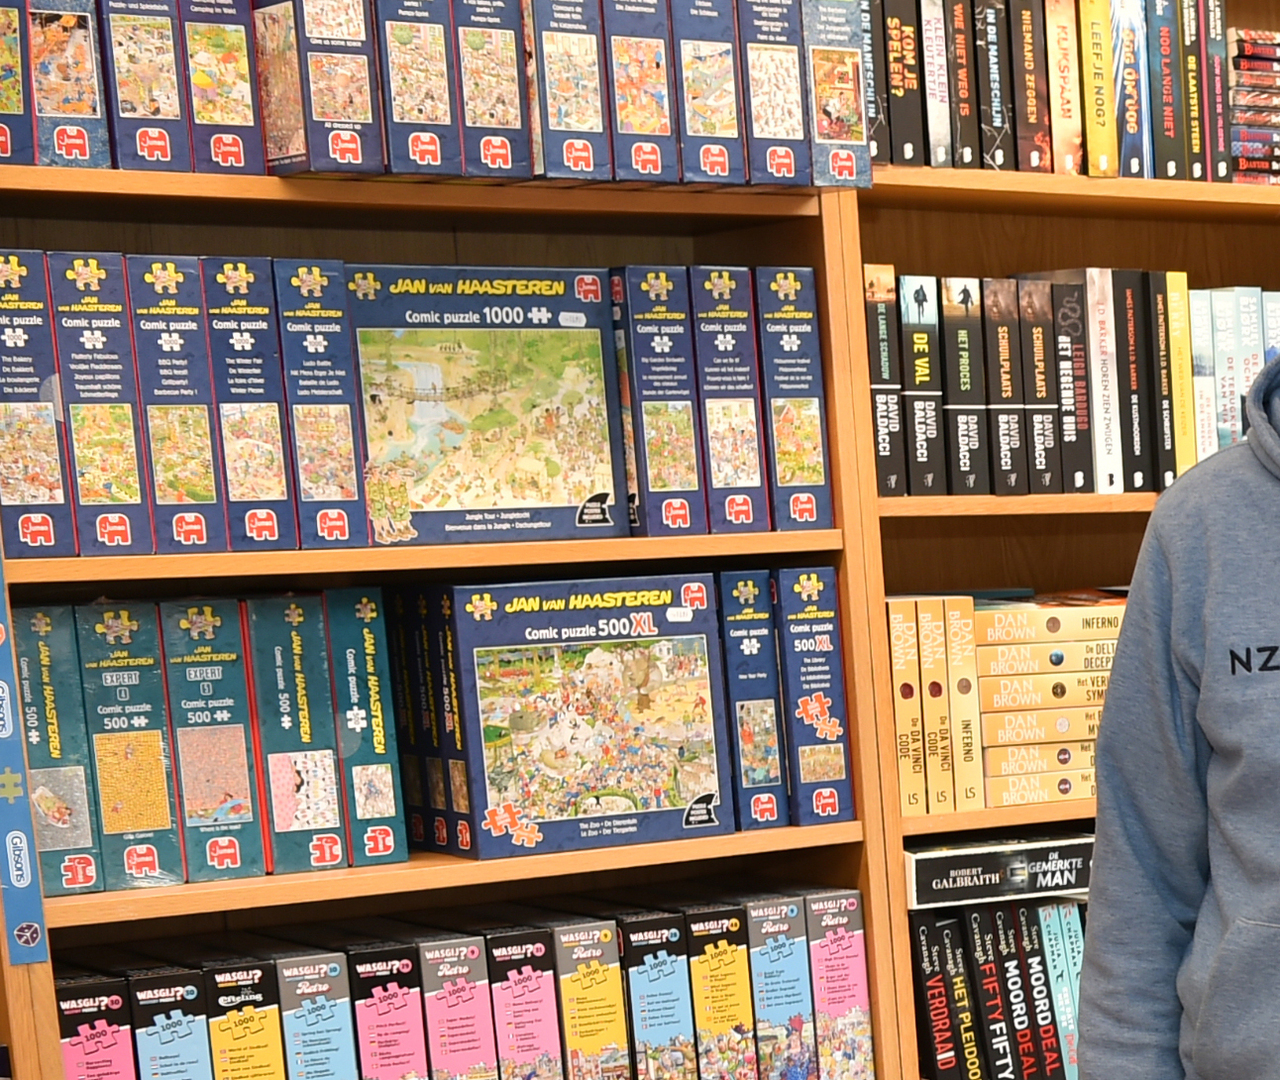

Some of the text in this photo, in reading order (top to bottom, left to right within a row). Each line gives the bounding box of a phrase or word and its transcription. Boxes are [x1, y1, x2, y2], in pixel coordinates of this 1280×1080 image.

[389, 278, 426, 294] JAN
[456, 279, 565, 295] HAASTEREN
[405, 308, 523, 325] Comic puzzle 1000
[913, 333, 931, 384] DE VAL
[998, 327, 1012, 398] SCHUILPLAATS
[994, 614, 1027, 627] DAN
[1082, 618, 1118, 629] INFERNO
[988, 627, 1035, 641] BROWN
[186, 667, 222, 680] EXPERT
[12, 835, 25, 883] Gibsons
[1049, 852, 1060, 860] DE
[950, 868, 982, 877] ROBERT
[1028, 859, 1083, 873] GEMERKTE
[932, 874, 1000, 890] GALBRAITH
[1036, 870, 1076, 887] MAN
[926, 975, 956, 1070] VERDRAAID
